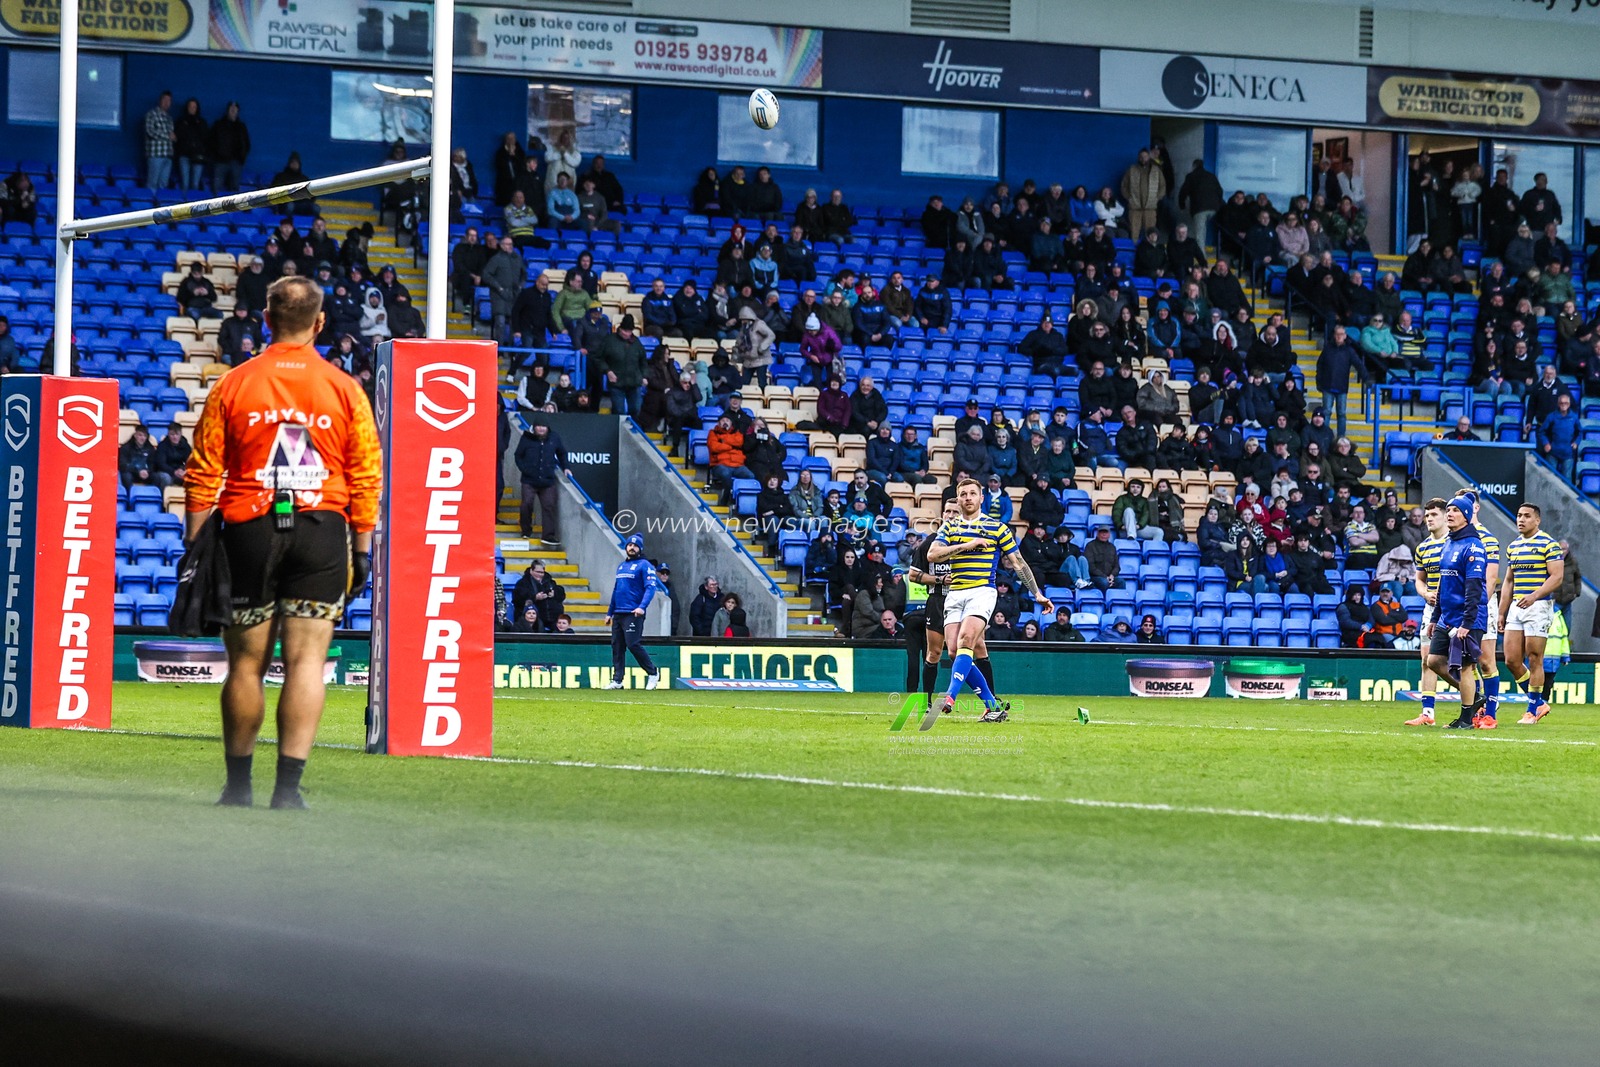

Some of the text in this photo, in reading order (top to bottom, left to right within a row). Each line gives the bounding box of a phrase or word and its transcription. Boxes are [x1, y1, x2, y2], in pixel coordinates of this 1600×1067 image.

[20, 9, 168, 33] FABCATIONS
[268, 21, 347, 37] RAWSON
[494, 13, 515, 27] Let
[520, 16, 536, 28] us
[541, 17, 573, 30] take
[577, 21, 609, 33] care
[613, 20, 627, 33] of
[268, 35, 346, 53] DIGITAL
[494, 33, 613, 51] your print needs
[634, 40, 768, 64] 01925 939784
[634, 60, 777, 78] www.rawsondigital.co.uk
[1193, 71, 1306, 103] SENECA
[1397, 83, 1524, 103] WARRINGTON
[1397, 98, 1525, 119] FABRICATIONS
[1, 465, 25, 719] BETFRED
[56, 466, 95, 721] BETFRED
[420, 446, 465, 748] BETFRED
[156, 664, 213, 676] RONSEAL
[1145, 680, 1194, 691] RONSEAL
[1241, 681, 1285, 691] RONSEAL
